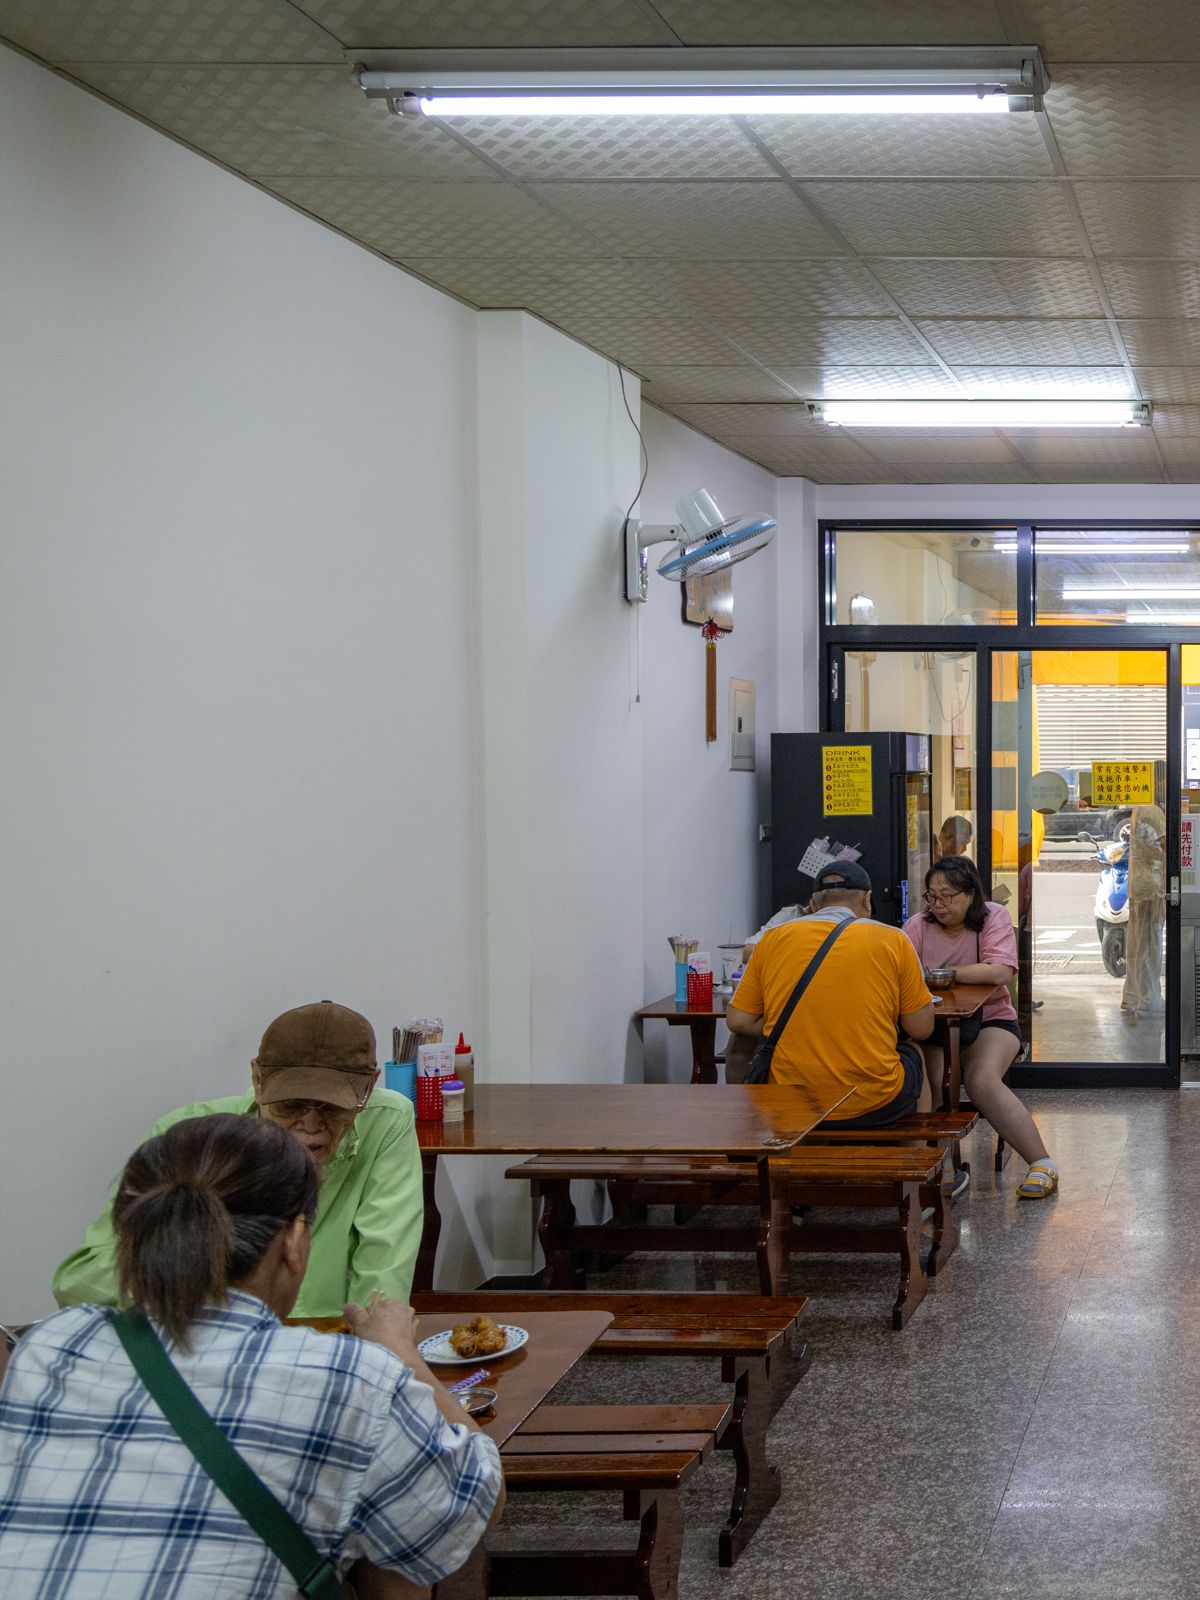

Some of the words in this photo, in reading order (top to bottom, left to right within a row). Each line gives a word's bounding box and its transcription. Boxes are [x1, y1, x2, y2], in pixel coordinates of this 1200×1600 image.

[1096, 765, 1149, 774] 常有交通警車
[1096, 794, 1132, 802] 車及汽車
[1181, 821, 1193, 868] 請先付款
